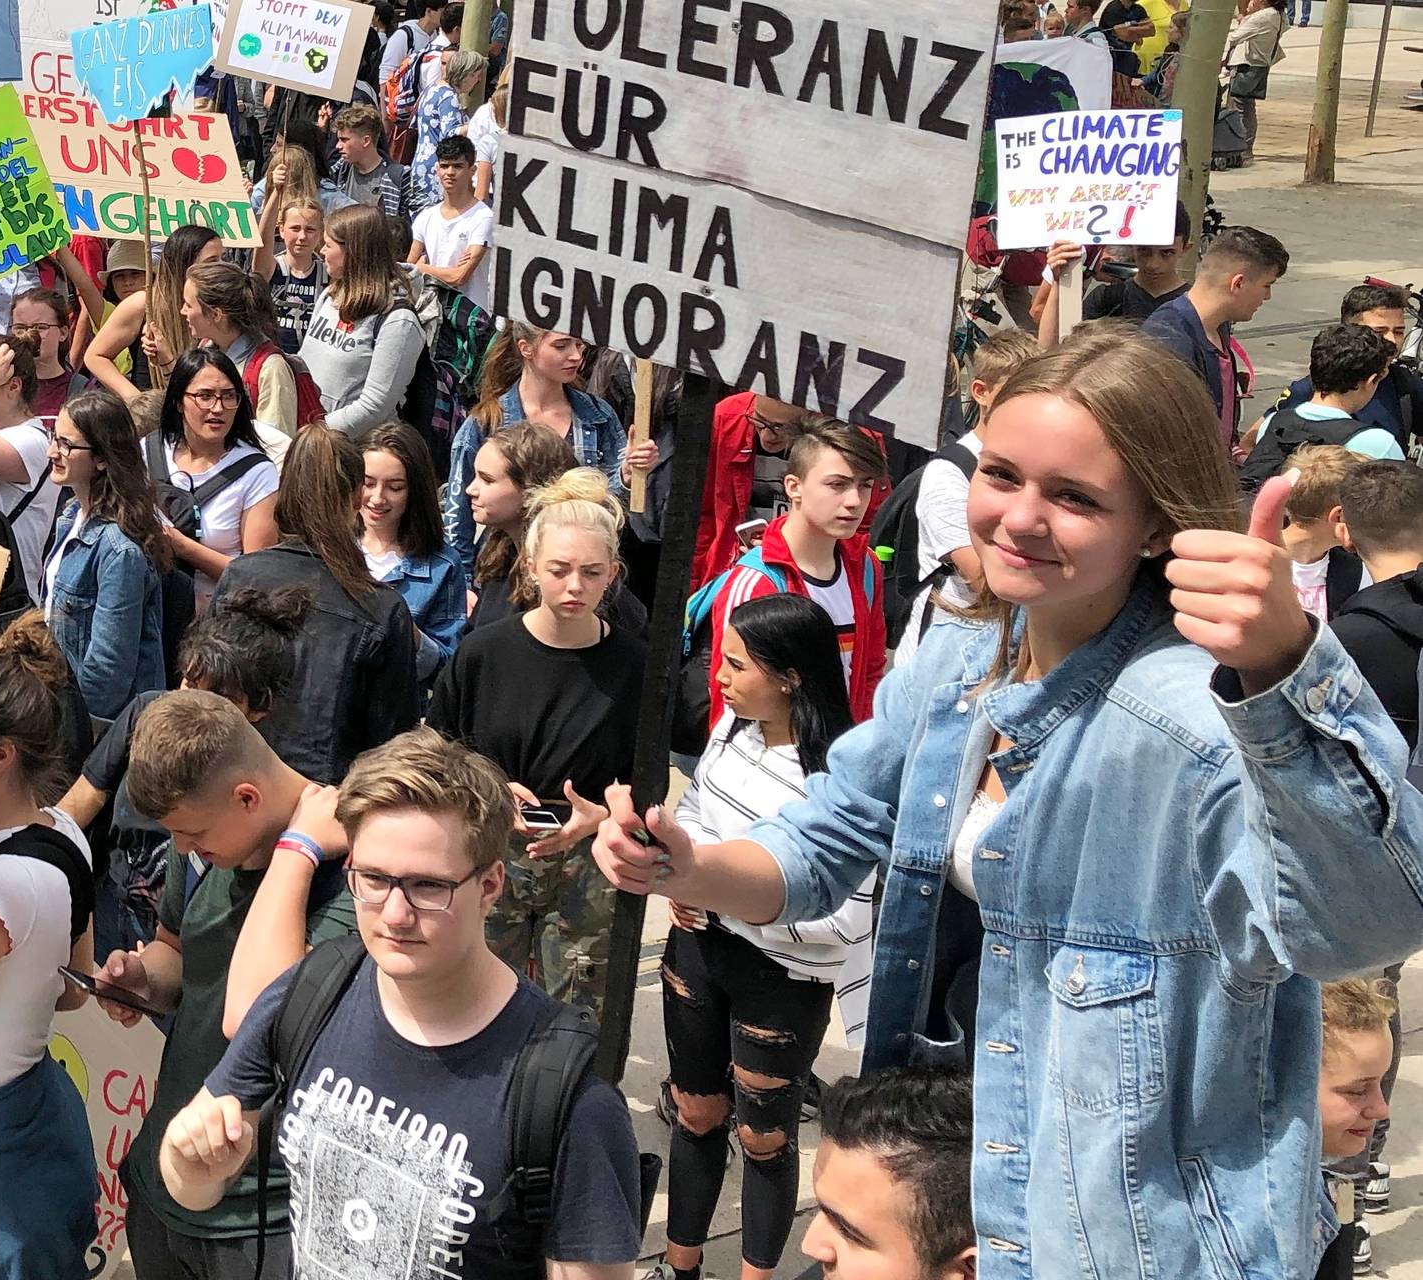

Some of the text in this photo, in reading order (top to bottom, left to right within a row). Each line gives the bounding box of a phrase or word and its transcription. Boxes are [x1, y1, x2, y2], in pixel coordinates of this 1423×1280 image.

[256, 0, 344, 28] STOPPT DEN
[260, 19, 338, 49] KLIMAWANDEL
[79, 20, 128, 71] GANZ
[113, 61, 146, 111] EIS
[509, 56, 668, 169] FÜR
[1001, 113, 1165, 149] THE CLIMATE
[60, 134, 160, 179] UNS
[1039, 142, 1182, 177] CHANGING
[99, 191, 252, 241] GEHÖRT
[498, 152, 740, 290] KLIMA
[1007, 186, 1059, 208] WHY
[492, 247, 907, 437] IGNORANZ
[102, 1069, 158, 1118] CA
